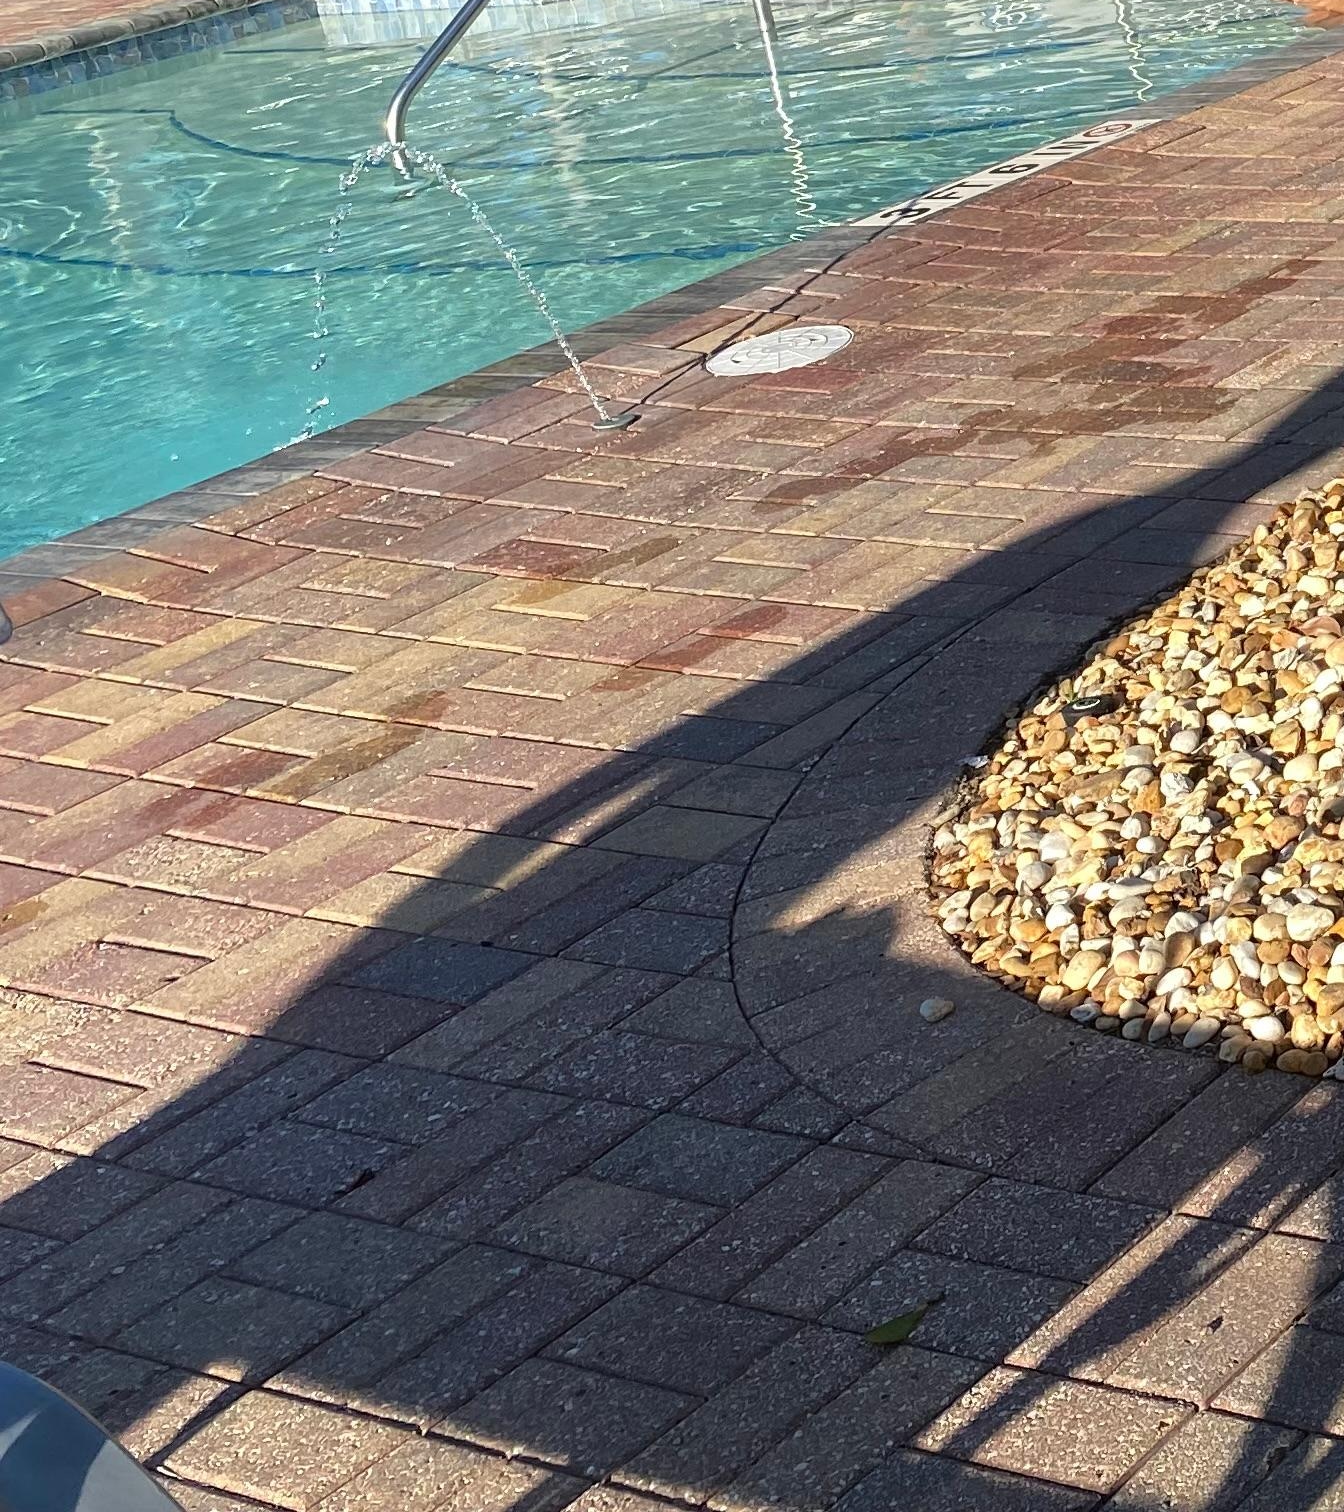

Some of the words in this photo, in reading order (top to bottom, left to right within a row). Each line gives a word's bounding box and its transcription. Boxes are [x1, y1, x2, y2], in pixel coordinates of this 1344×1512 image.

[880, 207, 931, 219] 3
[924, 181, 993, 201] FT
[989, 163, 1040, 175] 6
[1033, 140, 1099, 155] IN
